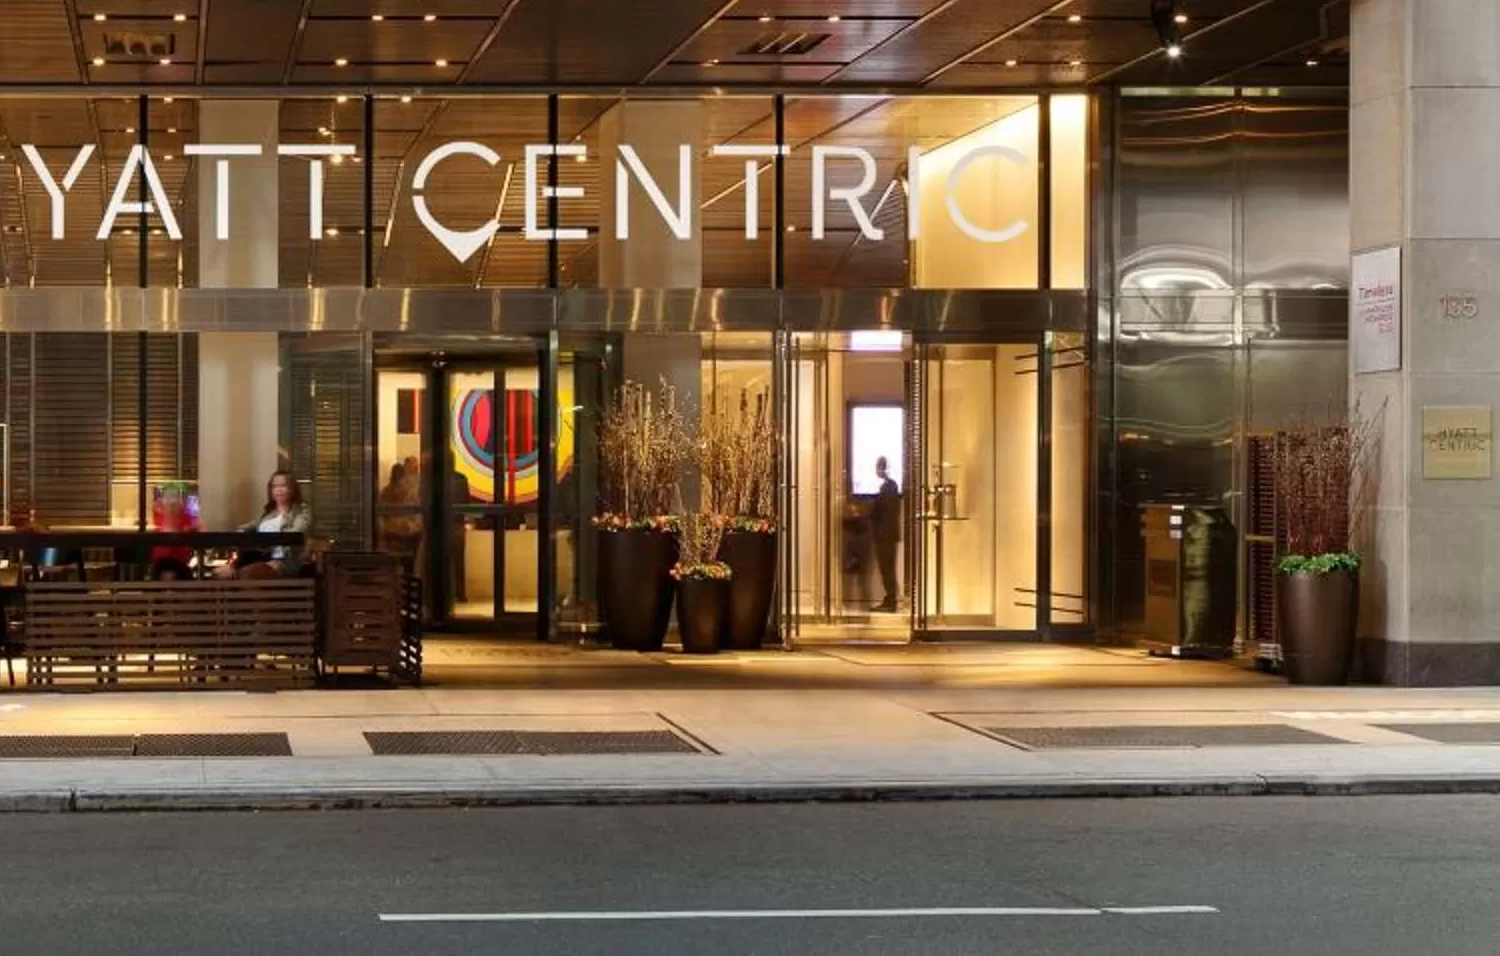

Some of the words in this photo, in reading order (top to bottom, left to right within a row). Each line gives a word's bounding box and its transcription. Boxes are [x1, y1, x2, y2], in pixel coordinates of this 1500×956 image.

[411, 142, 1030, 263] CENTRIC
[1440, 294, 1477, 318] 135
[1439, 427, 1477, 439] HYATT
